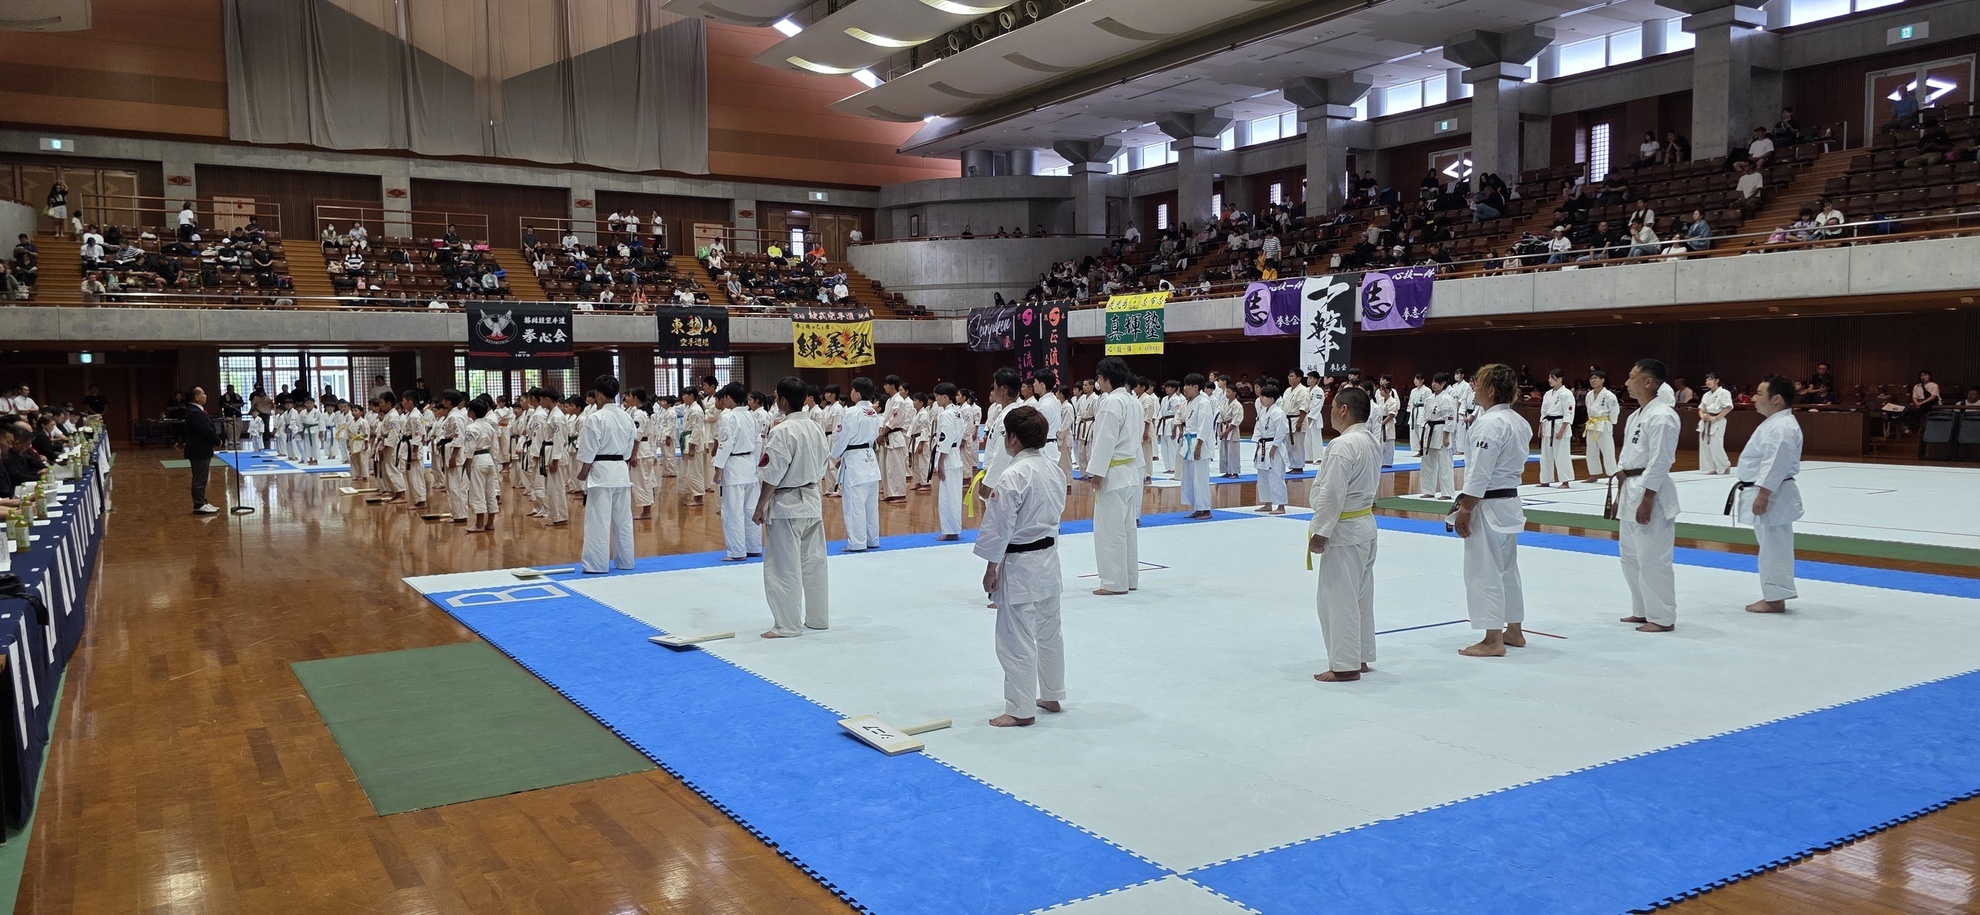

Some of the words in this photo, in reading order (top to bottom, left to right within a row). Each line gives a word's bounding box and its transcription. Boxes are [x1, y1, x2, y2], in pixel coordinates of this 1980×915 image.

[1392, 270, 1436, 281] 心技一体
[1245, 289, 1268, 327] 志
[1362, 280, 1391, 321] 志
[1275, 315, 1300, 328] 拳志会
[1307, 282, 1350, 362] 一撃
[522, 328, 568, 344] 拳心会
[797, 330, 872, 361] 練義塾
[445, 584, 571, 608] B
